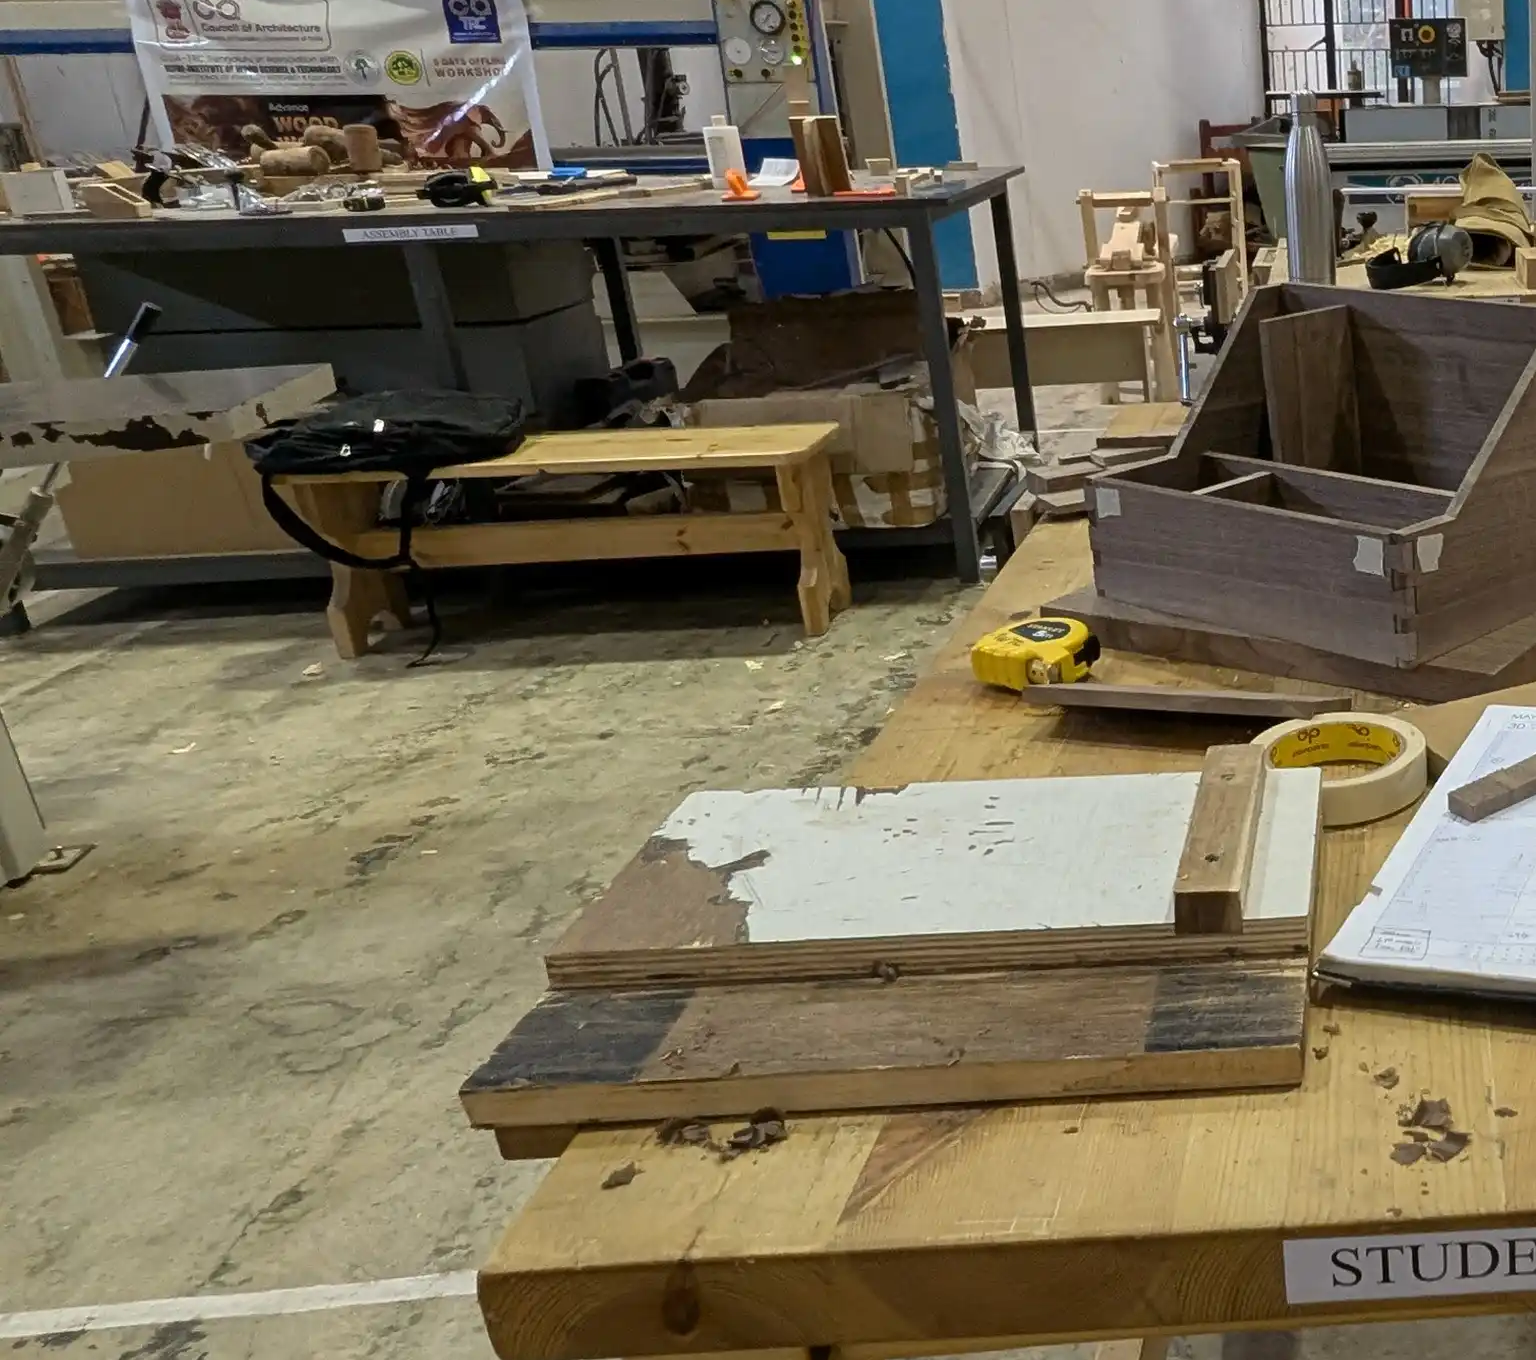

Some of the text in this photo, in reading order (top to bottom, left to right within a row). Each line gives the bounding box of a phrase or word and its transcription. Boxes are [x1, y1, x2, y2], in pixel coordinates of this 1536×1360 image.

[255, 23, 321, 34] Architecture
[362, 227, 458, 240] ASSEMBLY TABLE
